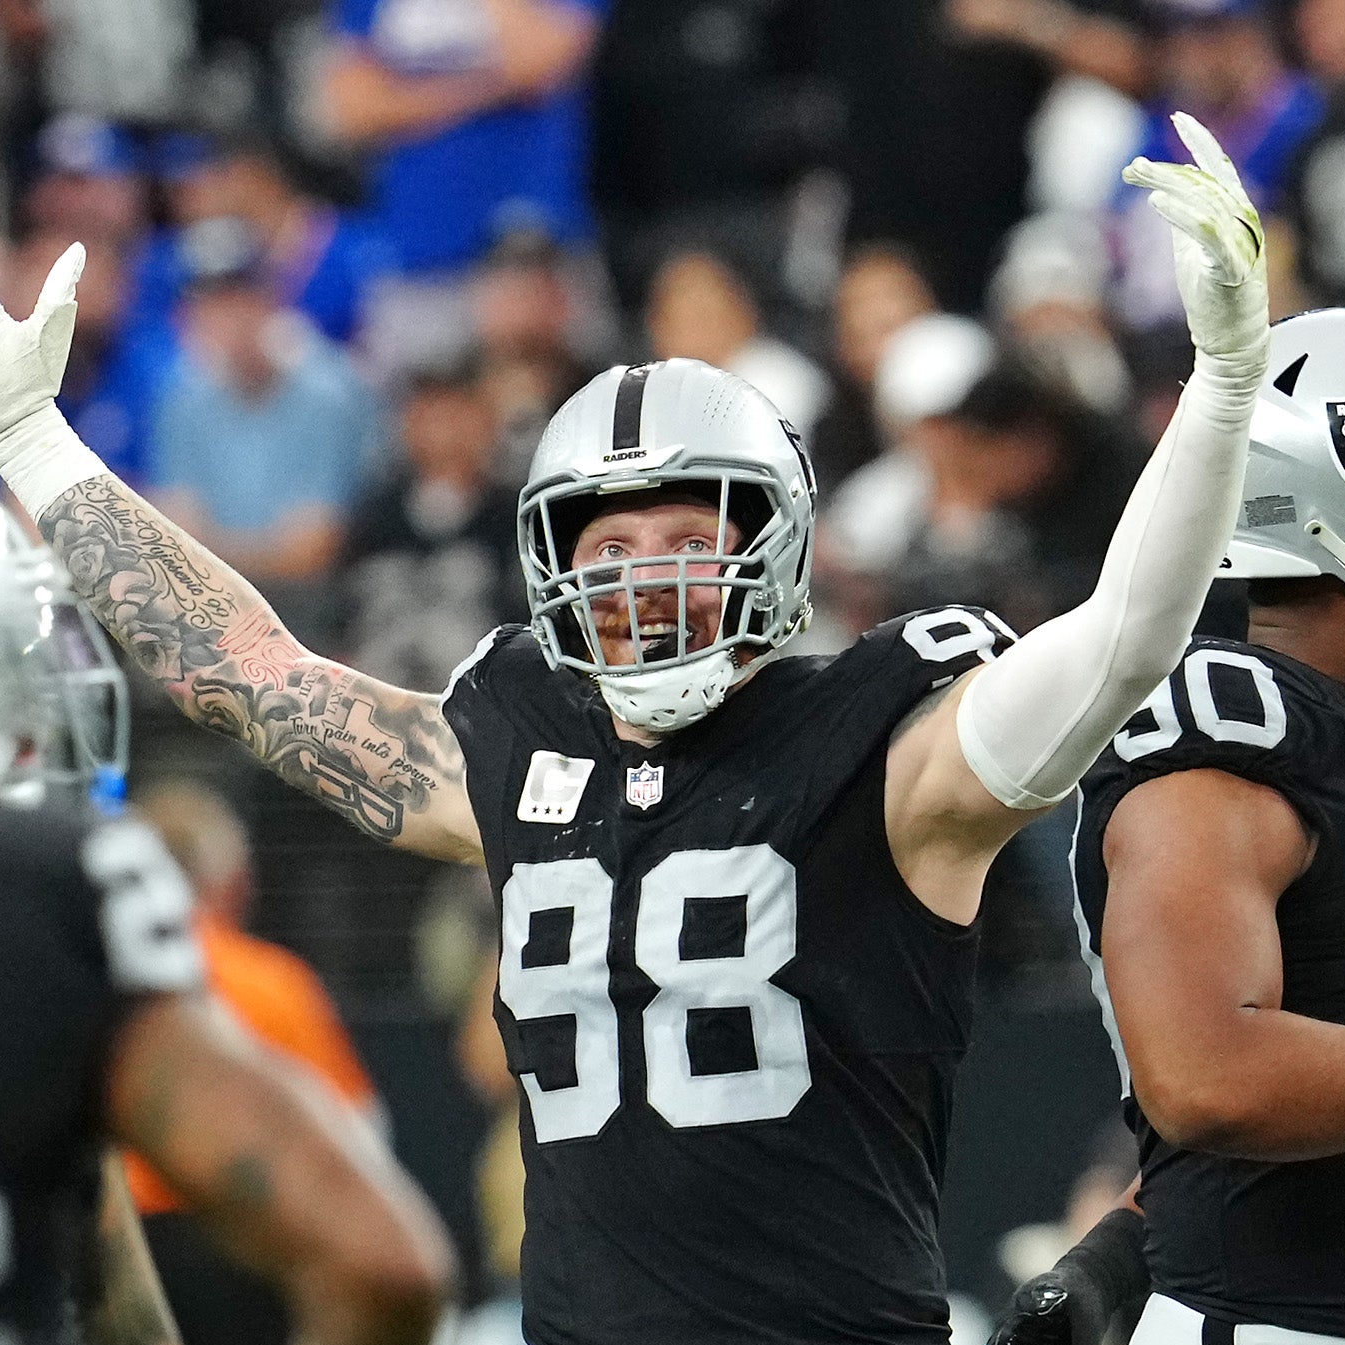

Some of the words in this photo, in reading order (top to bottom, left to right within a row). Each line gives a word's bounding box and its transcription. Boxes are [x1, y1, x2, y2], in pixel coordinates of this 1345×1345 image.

[603, 449, 647, 463] RAIDERS
[288, 716, 319, 737] Turn
[322, 724, 357, 745] pain
[360, 738, 392, 759] into
[388, 757, 440, 791] power
[530, 757, 585, 802] C
[633, 783, 657, 801] NFL
[499, 843, 812, 1143] 98
